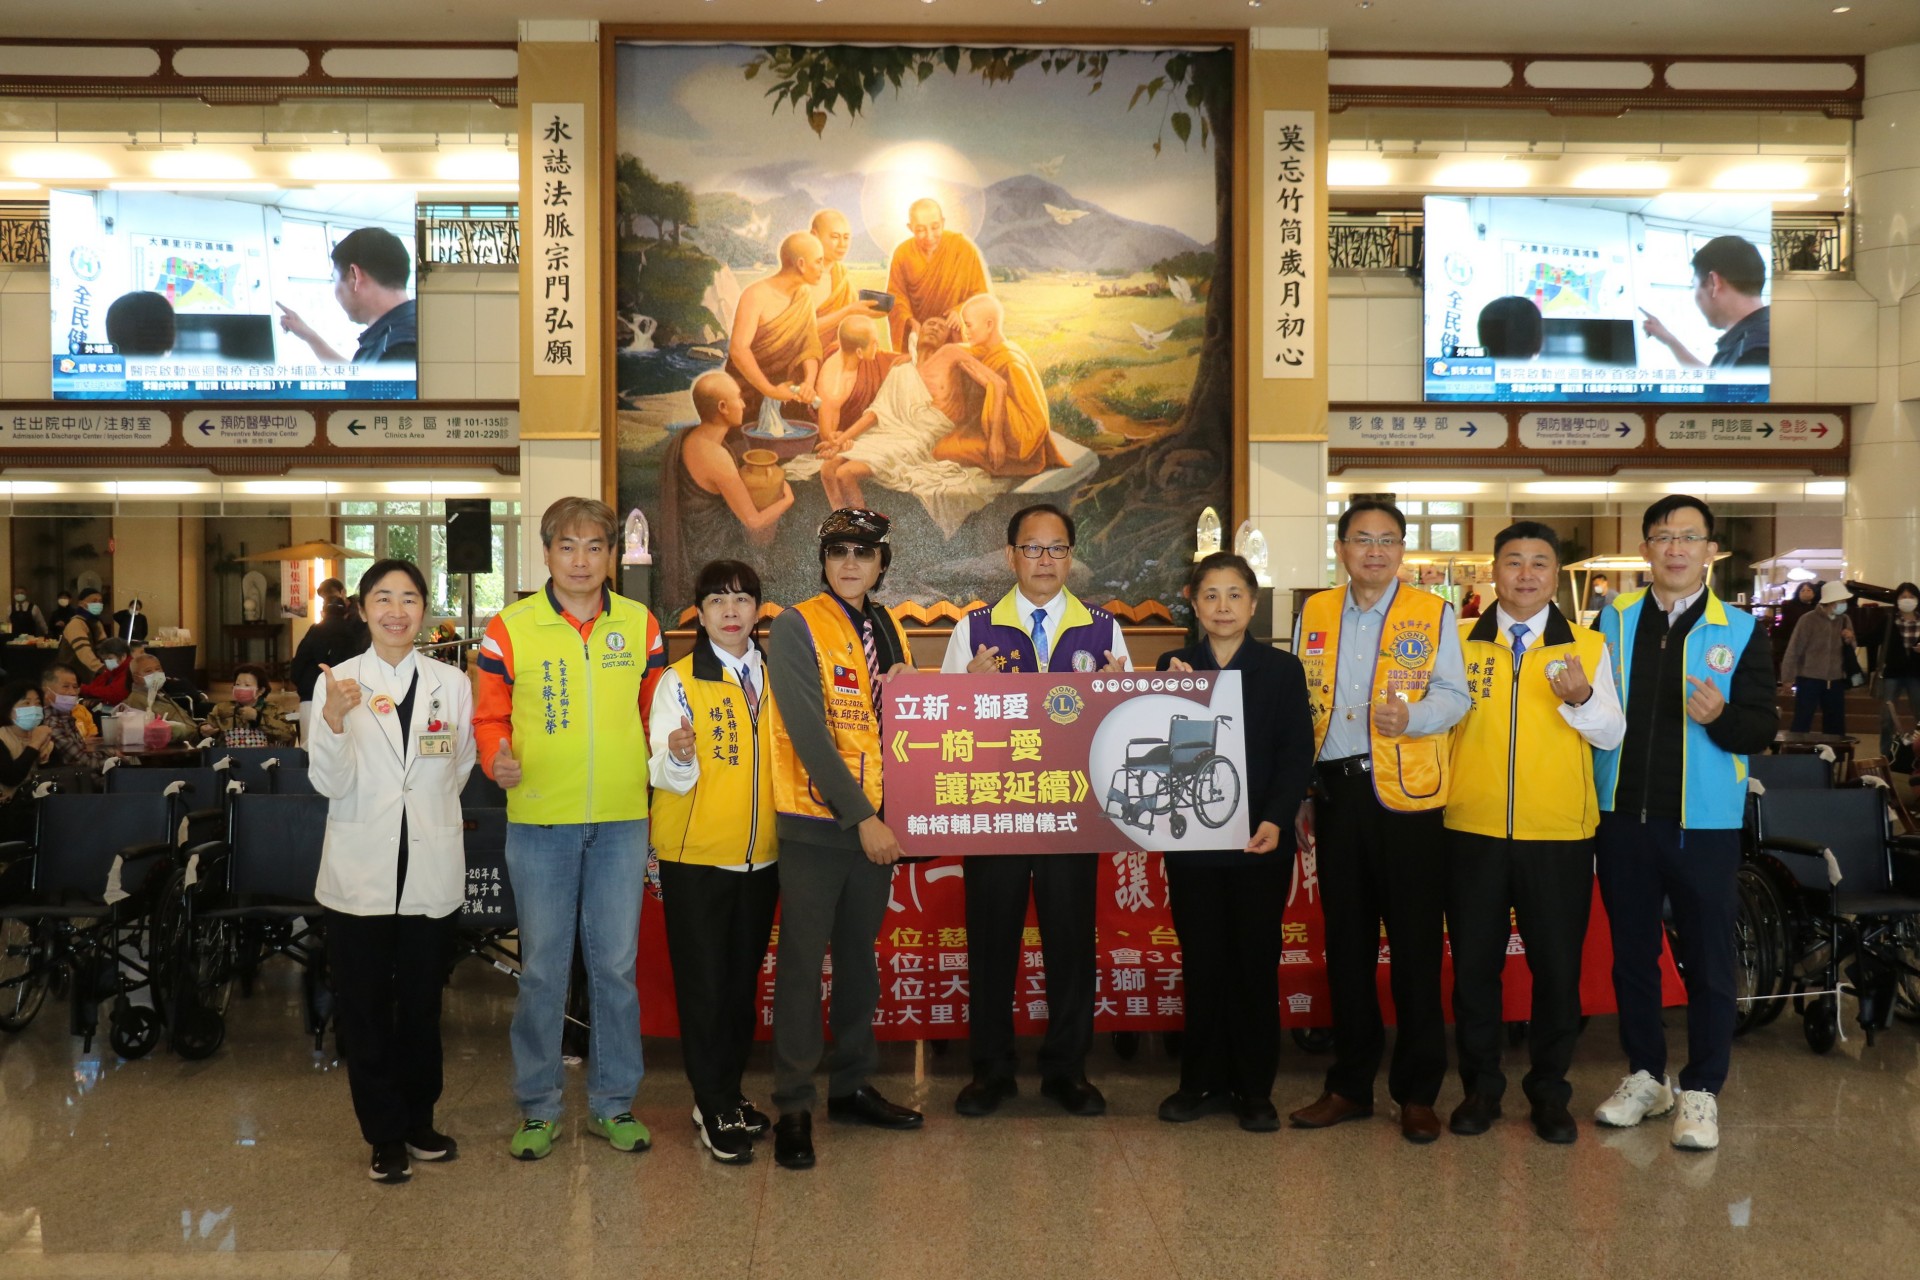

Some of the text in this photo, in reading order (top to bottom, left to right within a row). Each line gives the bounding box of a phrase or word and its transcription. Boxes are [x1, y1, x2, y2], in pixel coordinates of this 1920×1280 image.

[543, 115, 574, 366] 永誌法脈宗門弘願
[1275, 124, 1306, 367] 莫忘竹筒歲月初心
[13, 417, 151, 431] 住出院中心/注射室
[221, 416, 297, 430] 預防醫學中心
[374, 416, 437, 430] 門診區
[447, 417, 509, 427] 1樓 101-135診
[1349, 417, 1448, 431] 影像醫學部
[1536, 418, 1609, 431] 預防醫學中心
[1679, 420, 1696, 429] 2樓
[1711, 419, 1752, 433] 門診區
[1780, 420, 1808, 433] 急診
[446, 429, 509, 439] 2樓 201-229診
[1399, 632, 1425, 641] LIONS
[1407, 641, 1418, 656] L
[602, 651, 632, 661] 2025-2026
[1388, 669, 1431, 680] 2025-2026
[1481, 657, 1495, 699] 助理總監
[837, 686, 857, 695] TAIWAN
[1051, 686, 1076, 696] LIONS
[830, 698, 864, 708] 2025-2026
[1059, 697, 1070, 711] L
[709, 707, 726, 761] 楊秀文
[723, 697, 739, 766] 總監特別助理
[891, 729, 1042, 763] 《一椅一愛
[935, 770, 1091, 805] 讓愛延續》
[907, 812, 1078, 835] 輪椅輔具捐贈儀式
[1286, 992, 1313, 1014] 會
